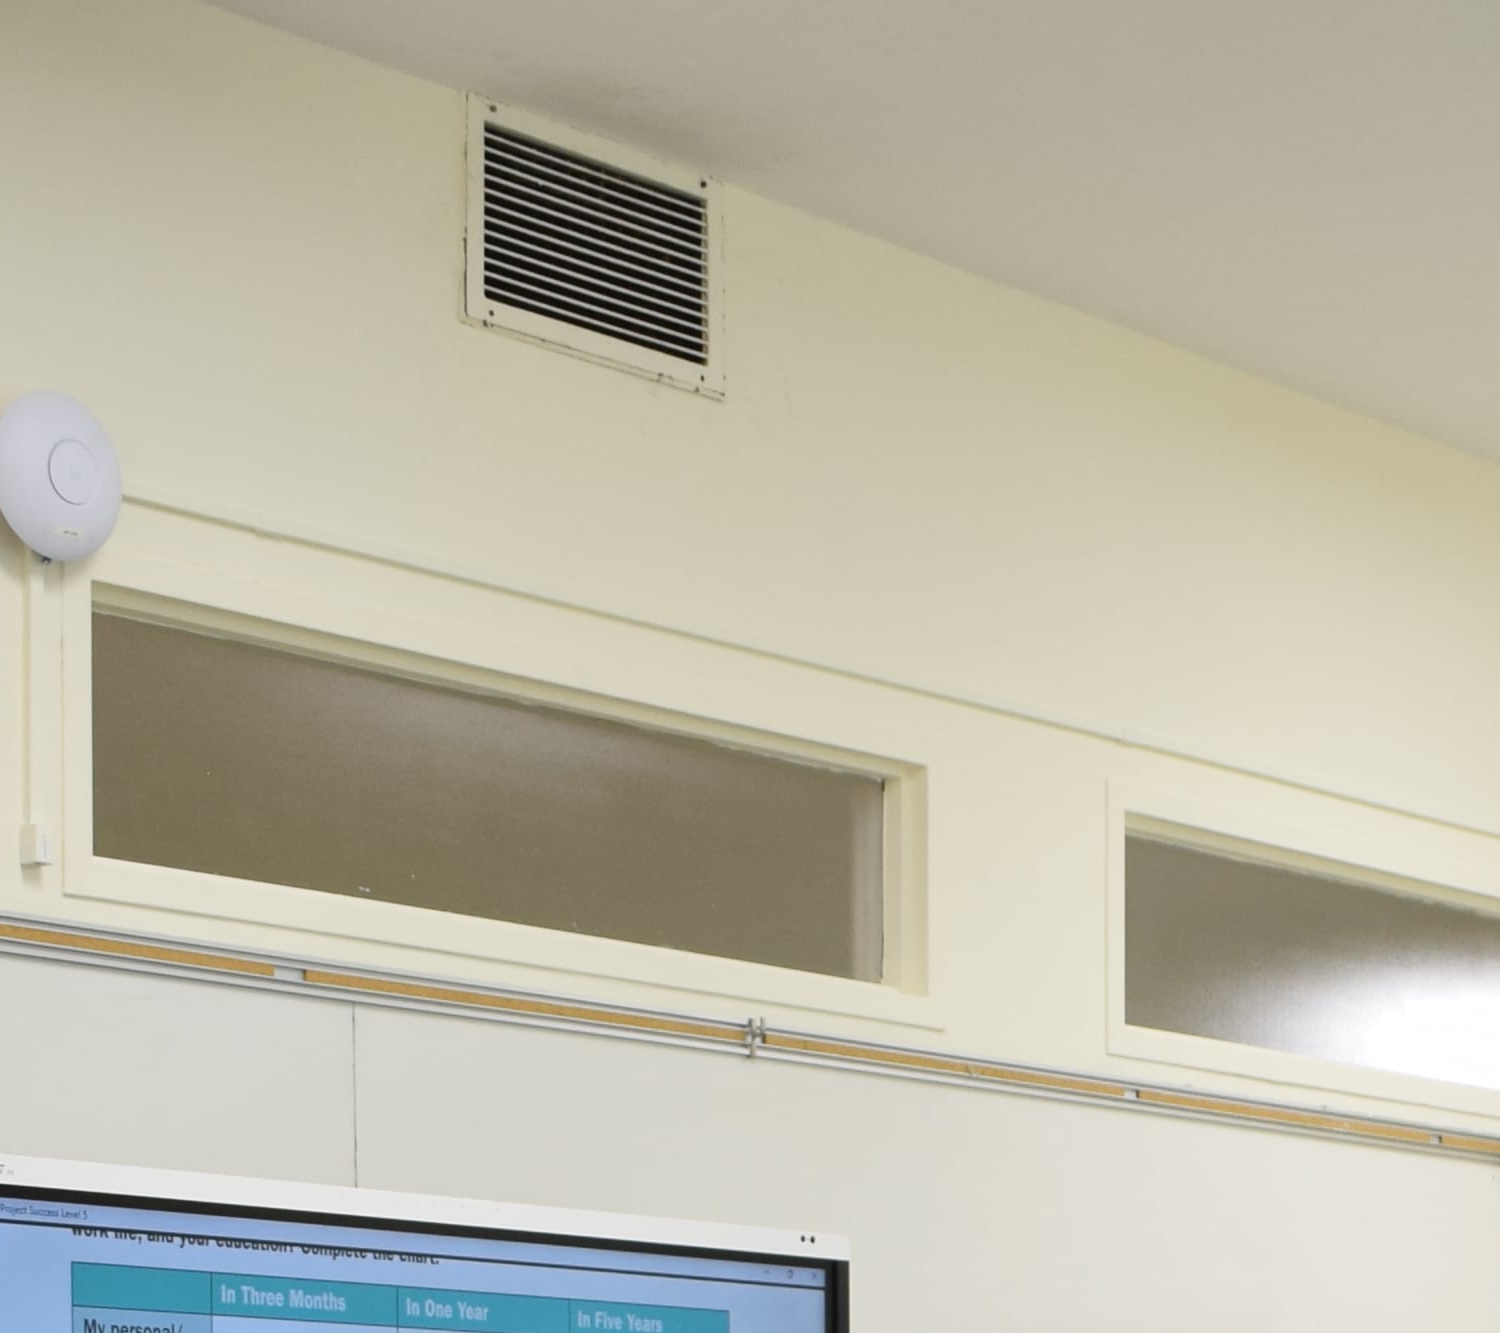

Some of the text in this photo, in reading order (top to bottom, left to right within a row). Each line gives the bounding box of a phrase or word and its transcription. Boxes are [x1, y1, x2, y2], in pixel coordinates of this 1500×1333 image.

[0, 1204, 27, 1217] Project
[29, 1206, 59, 1218] Success
[62, 1209, 80, 1219] Level
[221, 1285, 347, 1310] In Three Months
[406, 1298, 488, 1321] In One Year
[577, 1310, 663, 1333] In Five Years
